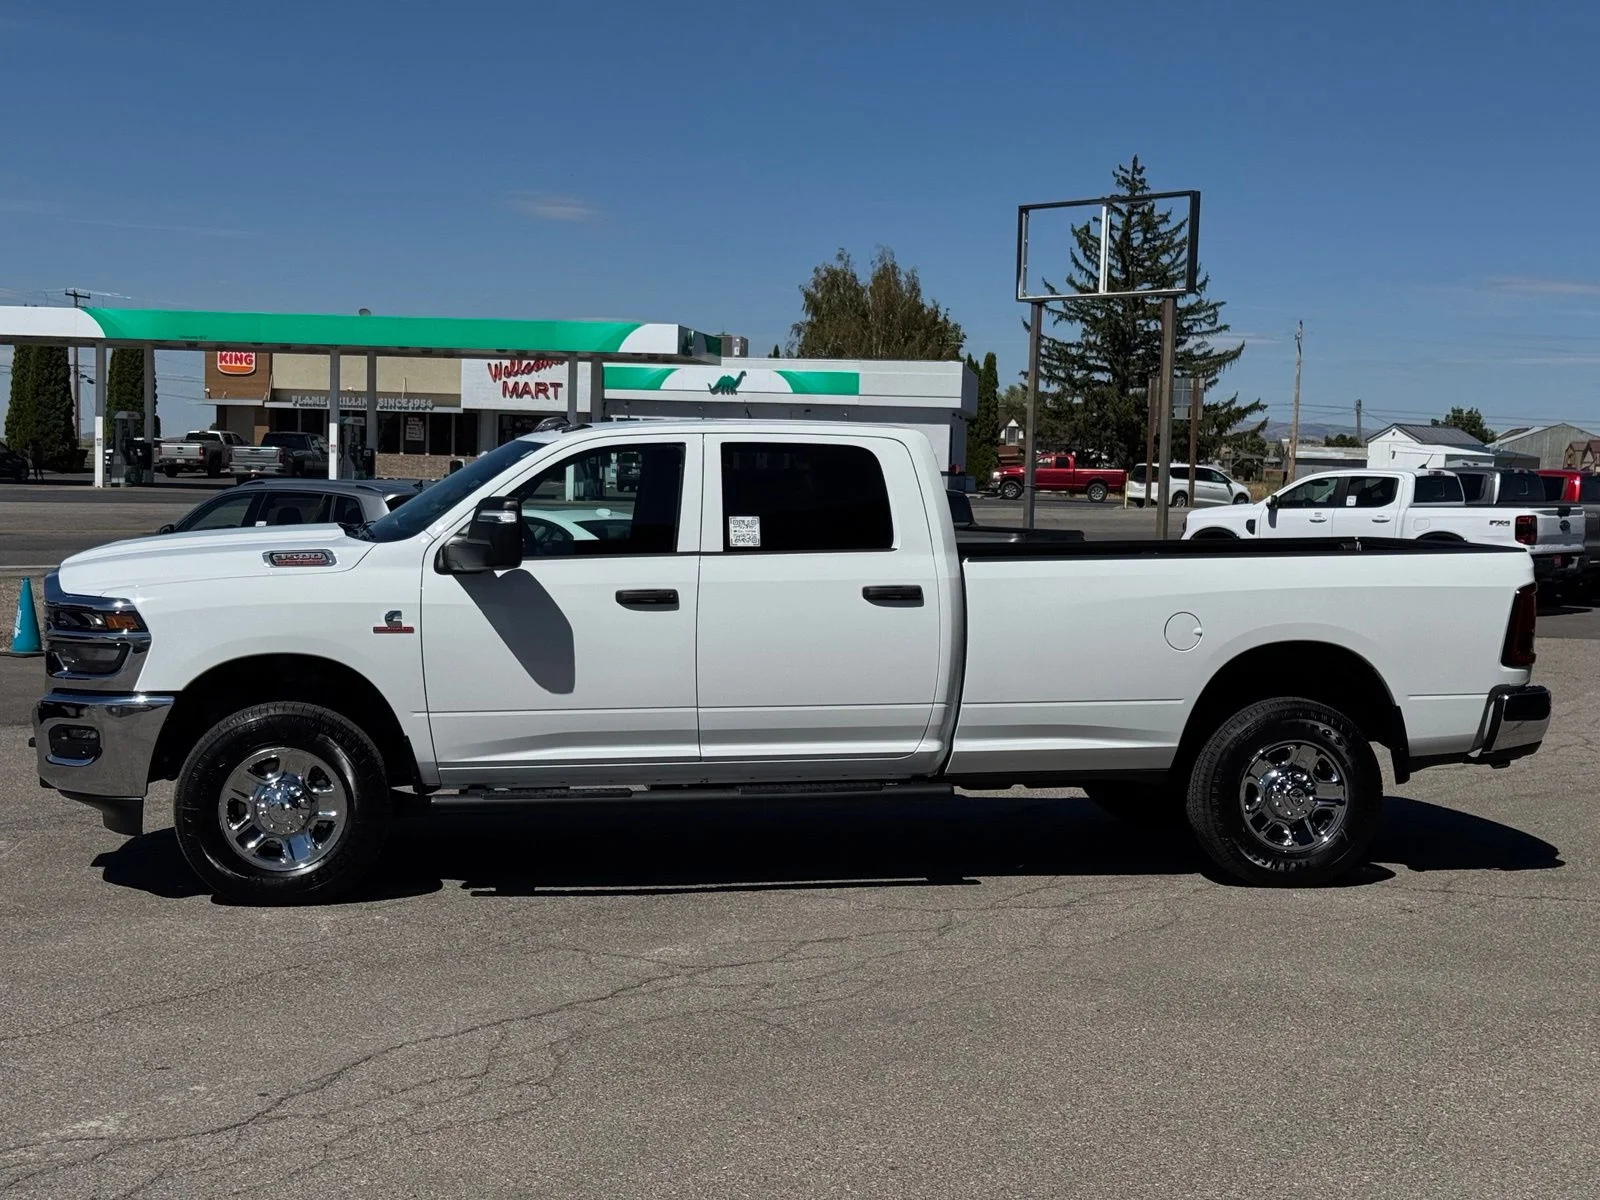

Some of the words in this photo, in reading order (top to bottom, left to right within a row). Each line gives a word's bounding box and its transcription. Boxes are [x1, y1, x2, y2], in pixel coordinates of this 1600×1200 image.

[219, 353, 254, 366] KING
[502, 380, 563, 400] MART
[291, 395, 326, 405] FLAME
[377, 397, 408, 407] SINCE
[409, 398, 433, 408] 1954
